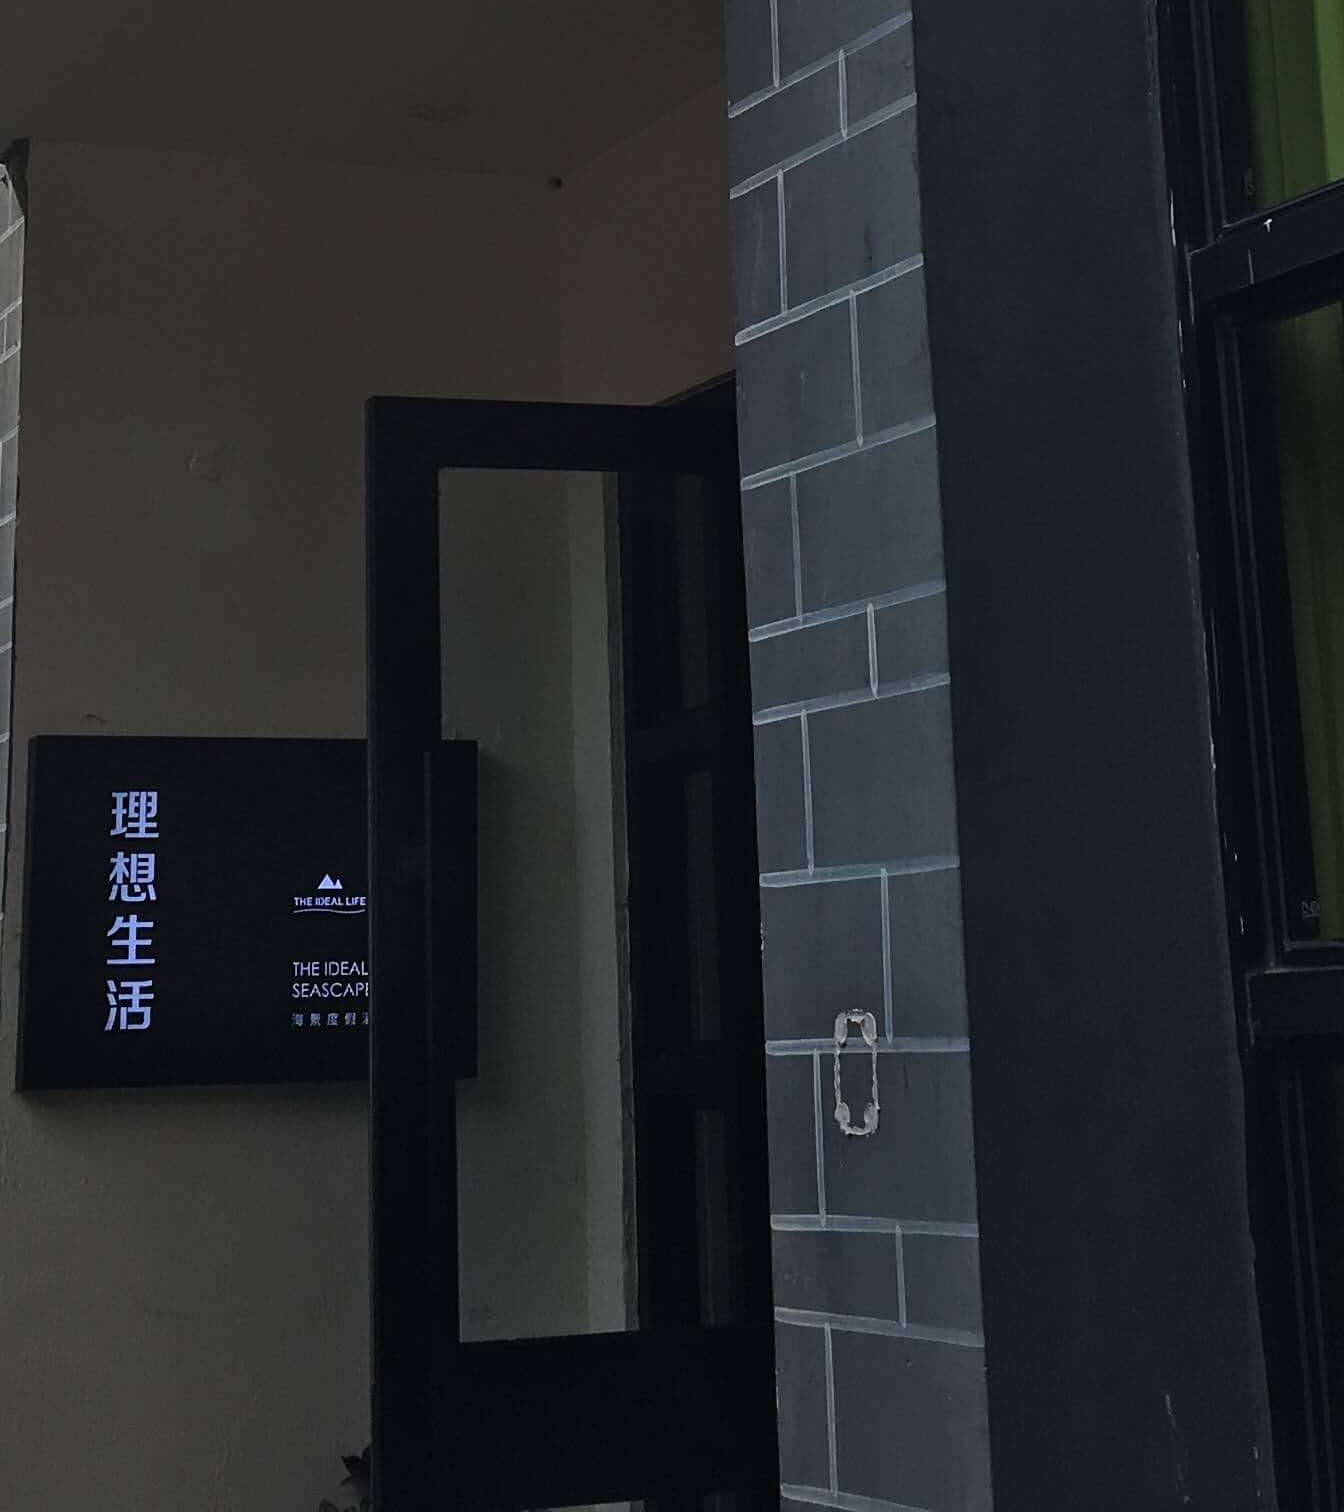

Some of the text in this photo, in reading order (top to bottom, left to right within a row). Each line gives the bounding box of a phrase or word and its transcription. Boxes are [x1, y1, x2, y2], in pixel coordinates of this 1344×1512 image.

[293, 896, 367, 907] THE IDEAL LIFE
[104, 790, 159, 1031] 理想生活
[292, 961, 369, 977] THE IDEAL
